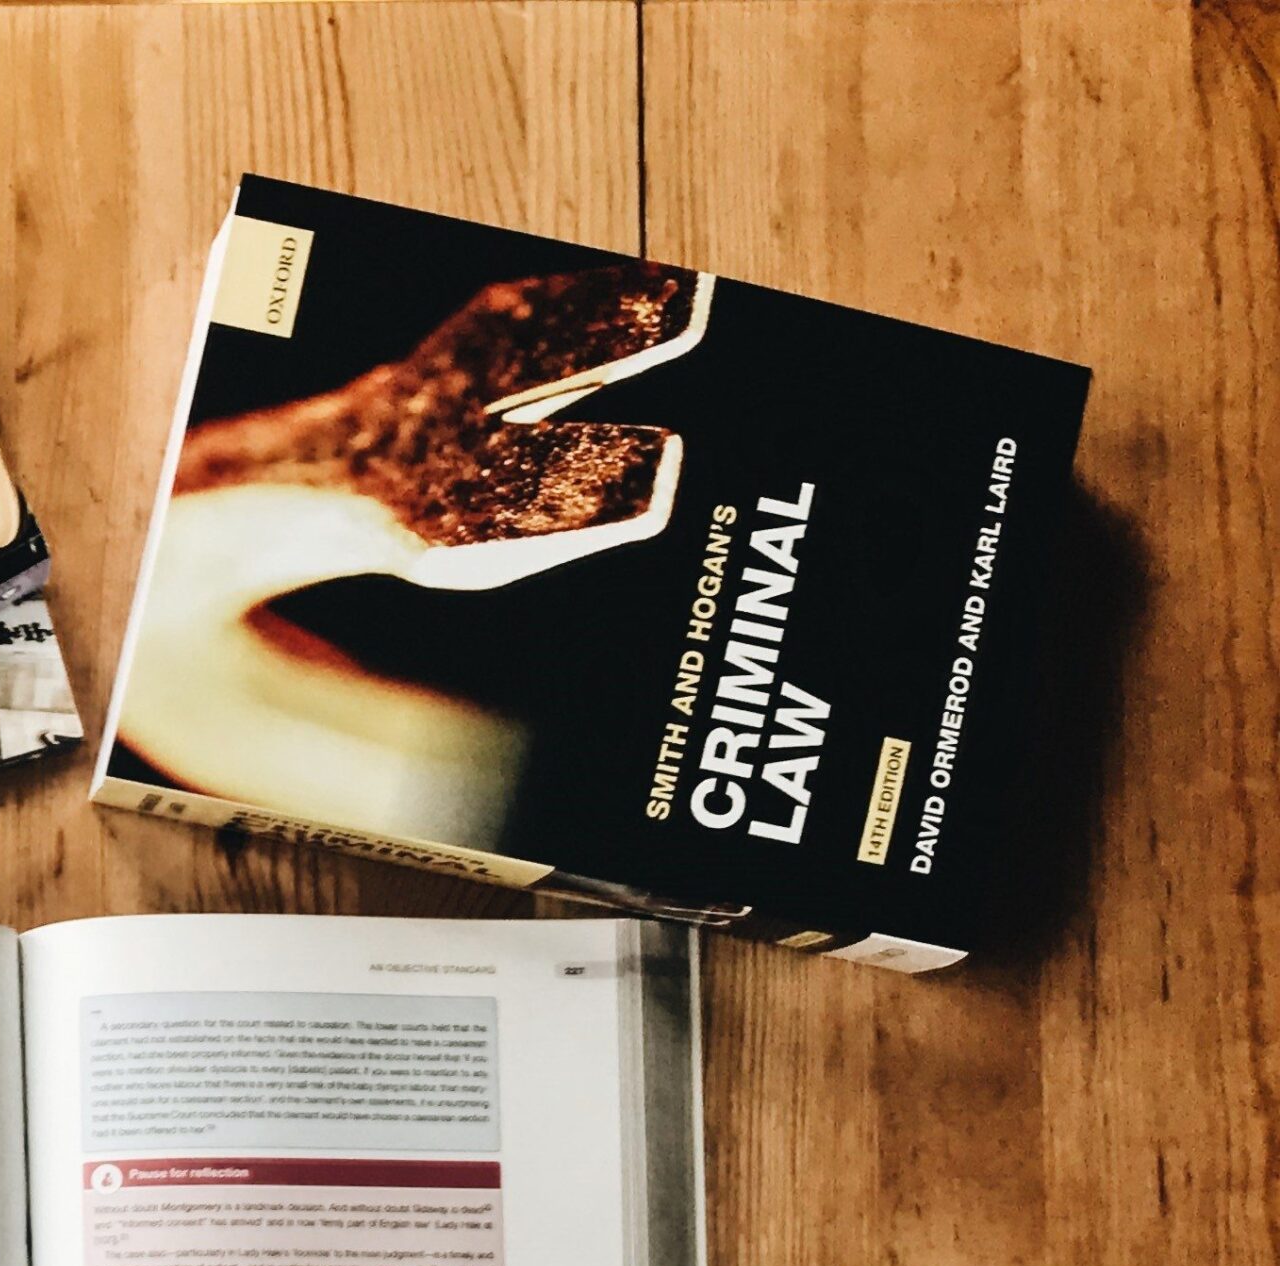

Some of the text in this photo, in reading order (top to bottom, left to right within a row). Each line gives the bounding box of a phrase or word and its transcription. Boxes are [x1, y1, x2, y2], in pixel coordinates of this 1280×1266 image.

[267, 237, 297, 324] OXFORD
[646, 504, 738, 820] SMITH AND HOGAN'S
[690, 482, 815, 829] CRIMINAL
[910, 436, 1017, 875] DAVID ORMEROD AND KARL LAIRD
[747, 681, 832, 845] LAW
[868, 745, 904, 858] 14TH EDITION
[129, 1167, 249, 1180] Pause for reflection
